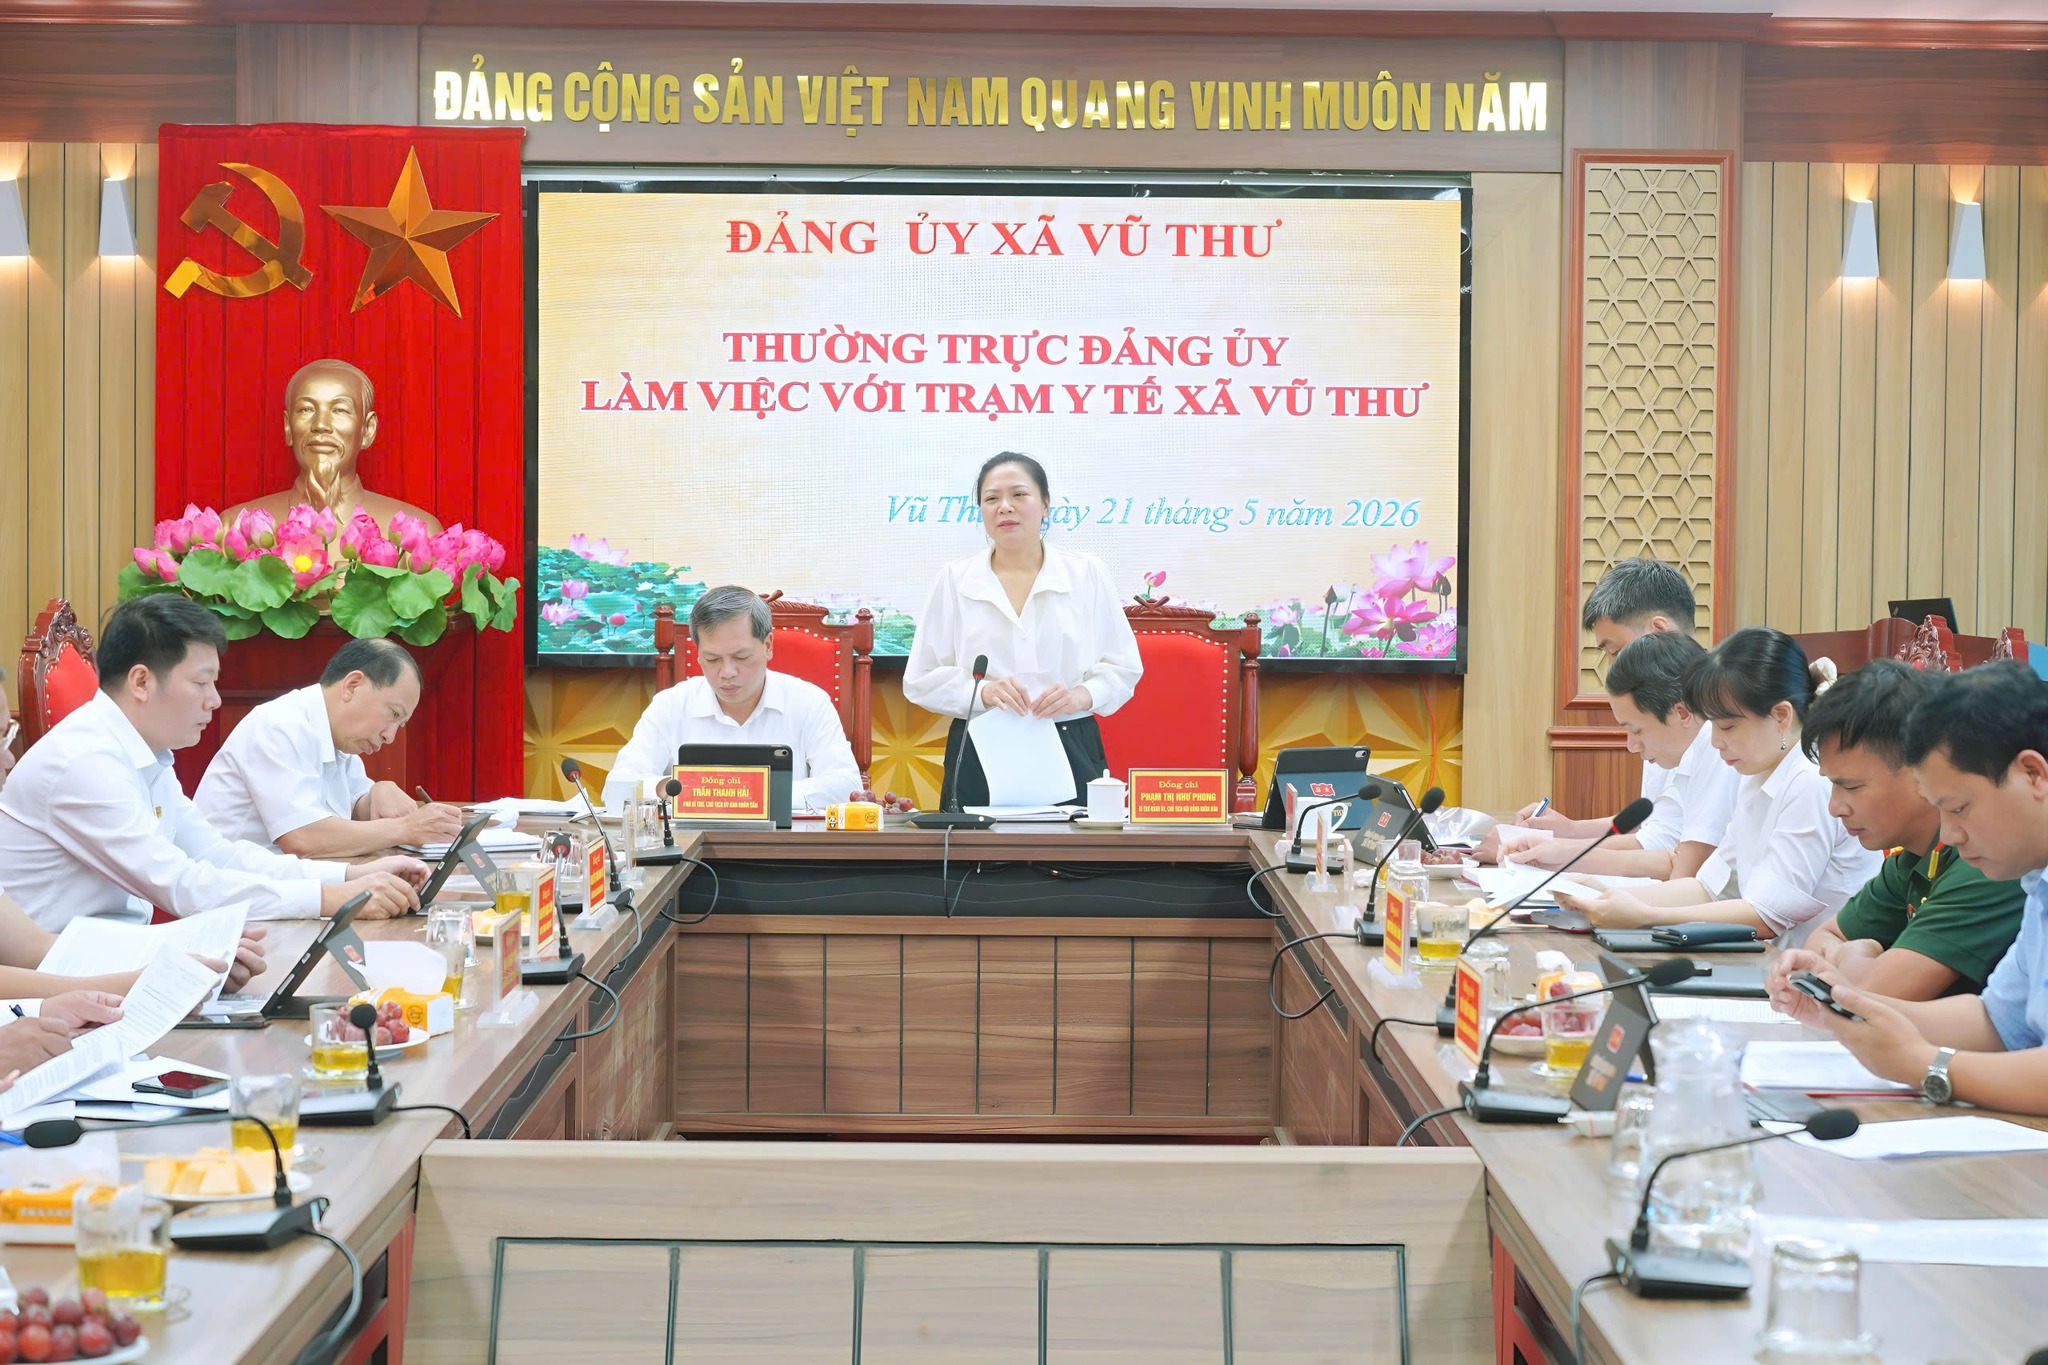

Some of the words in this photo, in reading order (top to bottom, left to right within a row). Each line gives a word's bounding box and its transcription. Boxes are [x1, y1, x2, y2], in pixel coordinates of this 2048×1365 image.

[434, 54, 553, 122] ĐẢNG
[564, 61, 680, 132] CỘNG
[693, 57, 783, 125] SẢN
[797, 65, 889, 137] VIỆT
[907, 76, 1009, 127] NAM
[1020, 77, 1175, 132] QUANG
[1190, 80, 1291, 130] VINH
[1303, 70, 1431, 131] MUÔN
[1444, 71, 1547, 131] NĂM
[726, 211, 878, 254] ĐẢNG
[905, 212, 978, 255] ỦY
[991, 214, 1064, 256] XÃ
[1078, 215, 1151, 256] VŨ
[1165, 219, 1283, 257] THƯ
[722, 324, 928, 364] THƯỜNG
[938, 329, 1068, 372] TRỰC
[1078, 326, 1213, 366] ĐẢNG
[1223, 328, 1290, 367] ỦY
[580, 372, 688, 412] LÀM
[697, 377, 810, 420] VIỆC
[819, 373, 906, 413] VỚI
[916, 383, 1055, 421] TRẠM
[1063, 384, 1097, 414] Y
[1104, 376, 1163, 415] TẾ
[1174, 378, 1241, 415] XÃ
[1249, 378, 1316, 416] VŨ
[1325, 382, 1430, 417] THƯ
[888, 495, 928, 523] Vũ
[1097, 497, 1132, 524] 21
[1144, 496, 1233, 532] tháng
[1239, 498, 1259, 526] 5
[1266, 498, 1333, 526] năm
[1342, 499, 1421, 527] 2026
[1141, 792, 1161, 803] PHẠM
[1163, 792, 1175, 803] THỊ
[1176, 791, 1192, 802] NHƯ
[1193, 792, 1216, 802] PHONG
